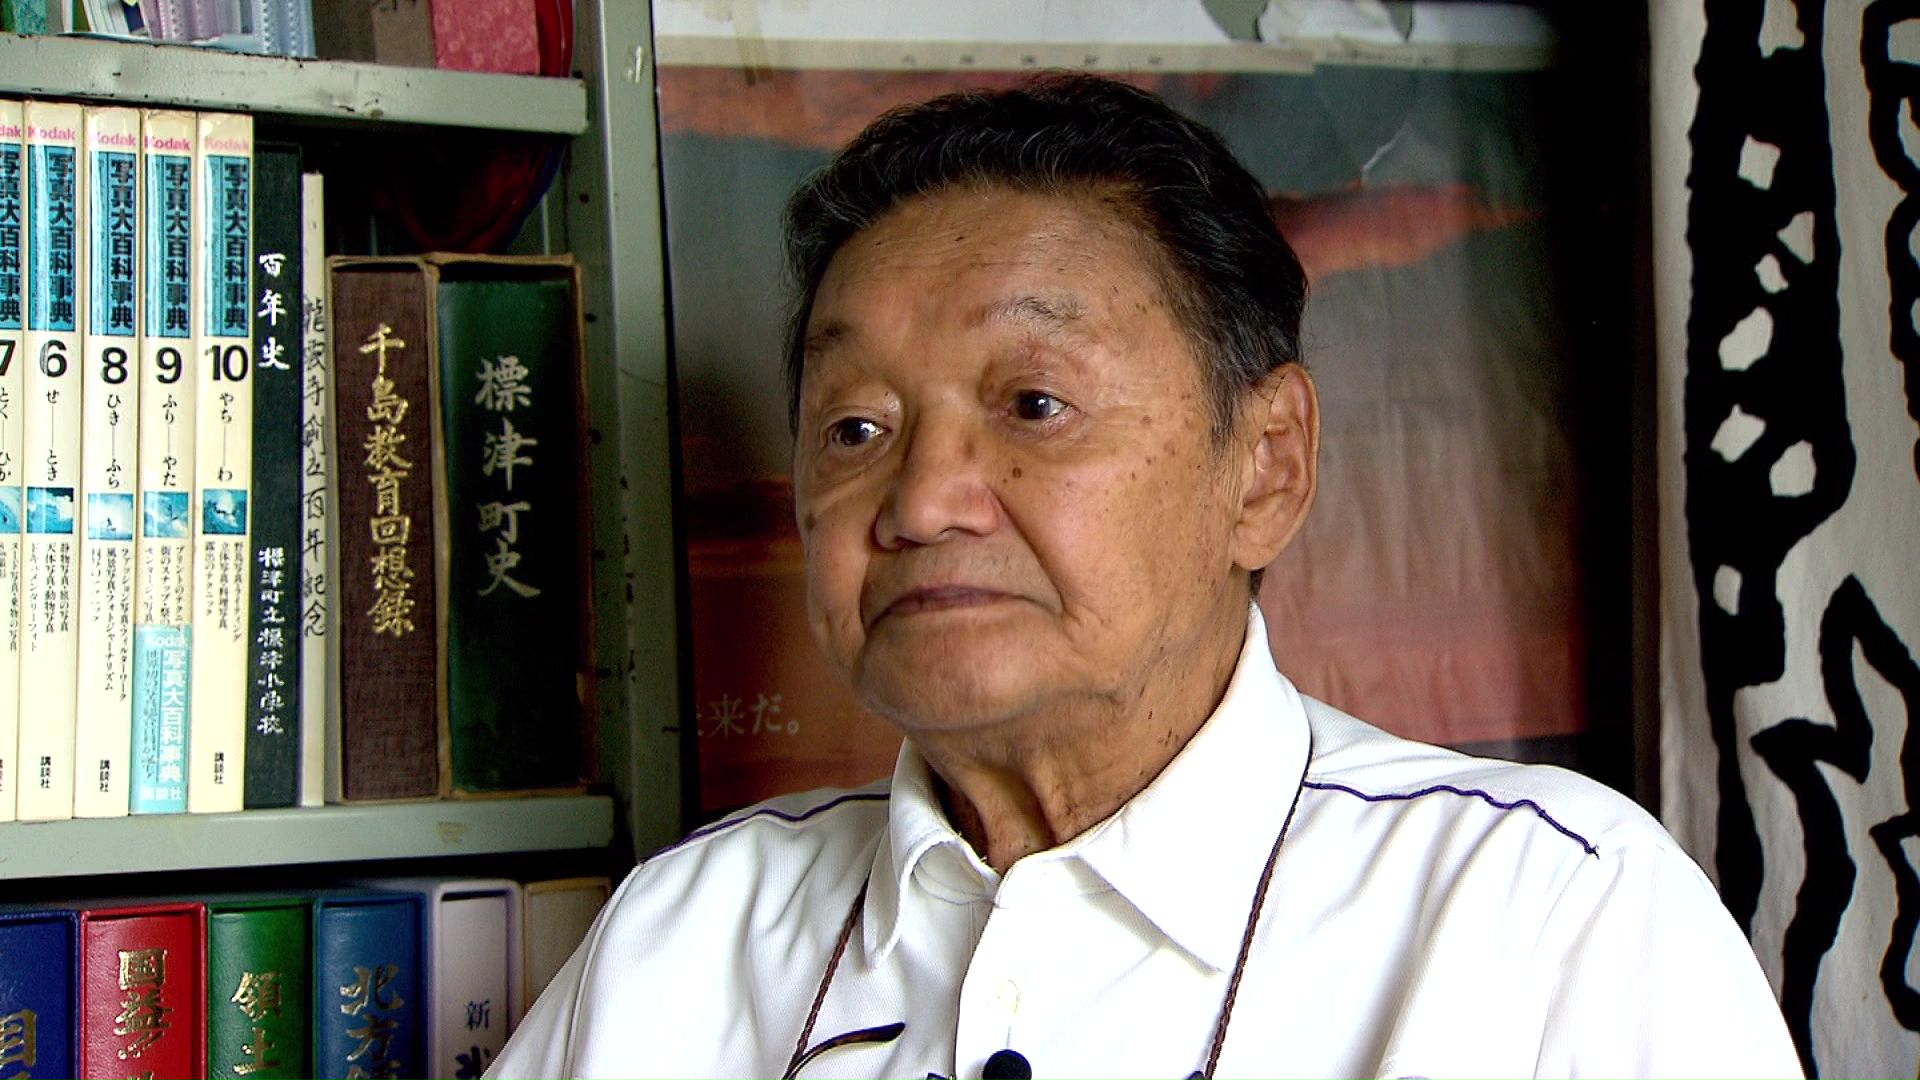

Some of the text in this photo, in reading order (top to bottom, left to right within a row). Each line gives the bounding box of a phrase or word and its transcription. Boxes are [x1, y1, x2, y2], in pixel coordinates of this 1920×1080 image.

[0, 125, 21, 138] dak
[204, 136, 249, 150] Kodak
[0, 152, 21, 323] 写真大百科事典
[50, 152, 73, 324] 写真大百科事典
[111, 159, 134, 330] 写真大百科事典
[165, 162, 189, 331] 写真大百科事典
[223, 163, 247, 331] 写真大百科事典
[40, 339, 67, 378] 6
[207, 345, 249, 382] 10
[257, 253, 290, 371] 百年史
[101, 347, 128, 385] 8
[156, 347, 182, 385] 9
[475, 355, 541, 598] 標津町史
[697, 692, 800, 739] 来だ。
[231, 970, 282, 1077] 領土
